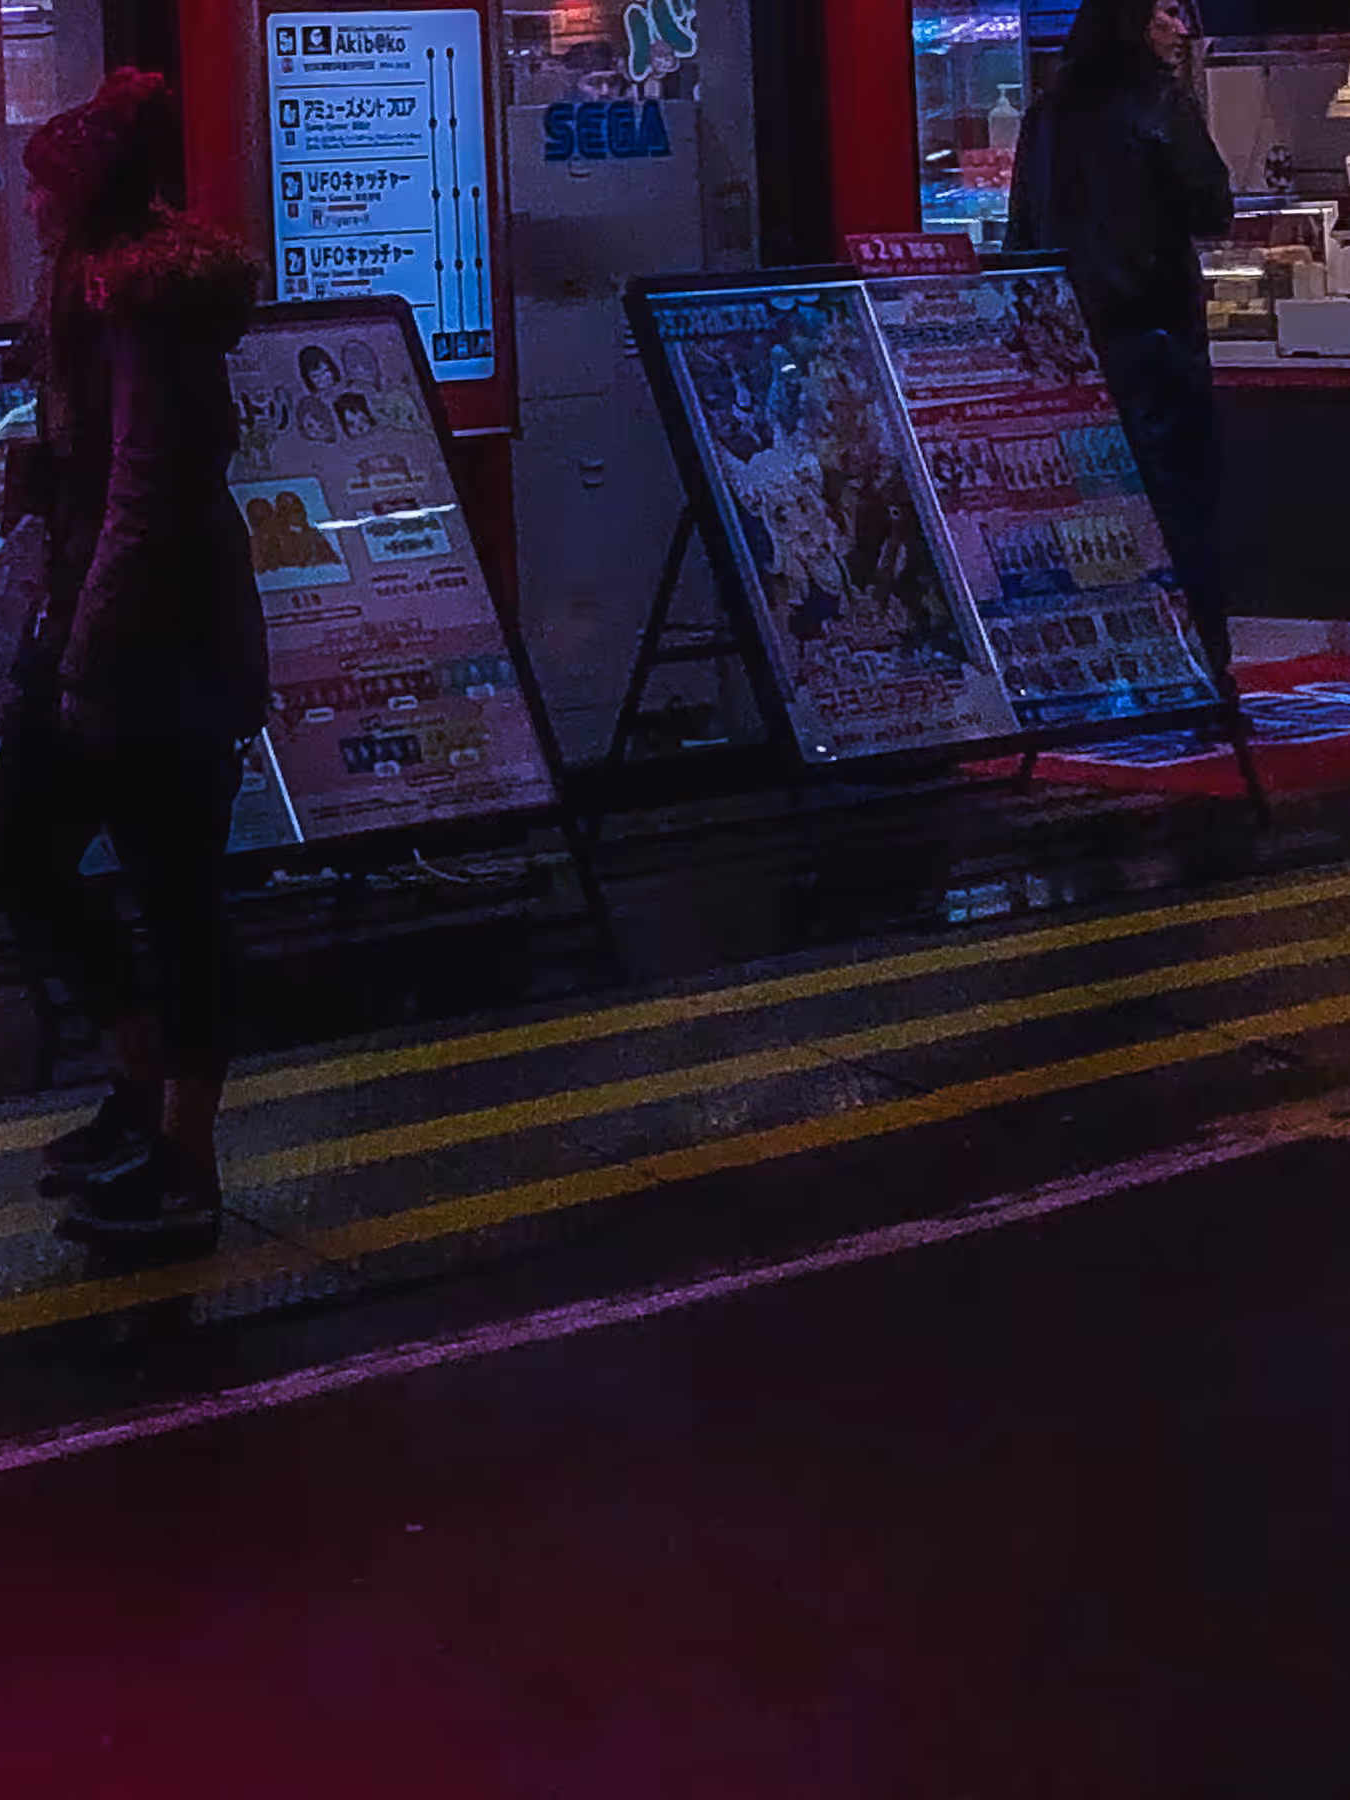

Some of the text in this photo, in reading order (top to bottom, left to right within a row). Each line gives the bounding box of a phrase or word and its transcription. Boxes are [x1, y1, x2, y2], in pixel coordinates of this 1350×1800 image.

[303, 96, 417, 121] アミューズメントフロア
[544, 99, 673, 161] SEGA
[308, 169, 411, 193] UFOキャッチャー
[310, 243, 415, 269] UFOキャッチャー
